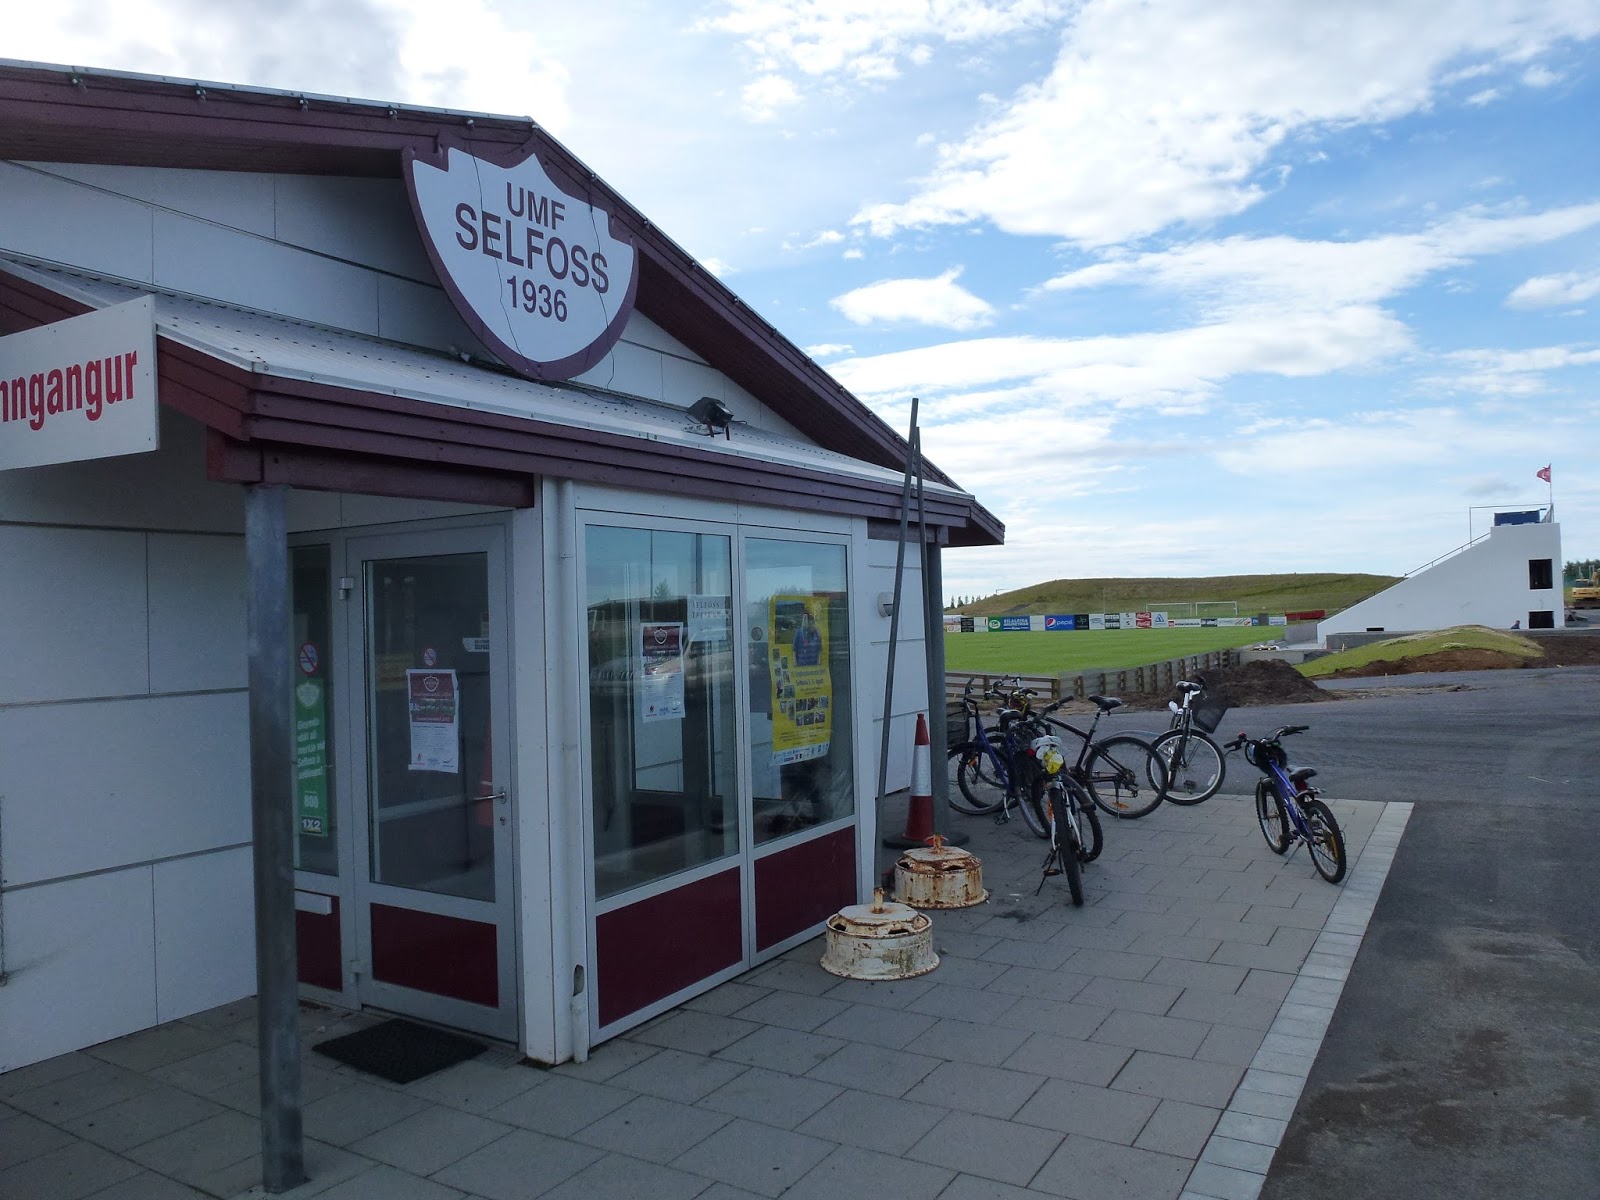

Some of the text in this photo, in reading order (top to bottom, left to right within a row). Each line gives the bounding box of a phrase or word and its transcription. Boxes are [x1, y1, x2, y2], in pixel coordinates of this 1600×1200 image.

[506, 181, 566, 230] UMF
[455, 202, 609, 294] SELFOSS
[506, 275, 568, 323] 1936
[302, 818, 321, 829] 1X2
